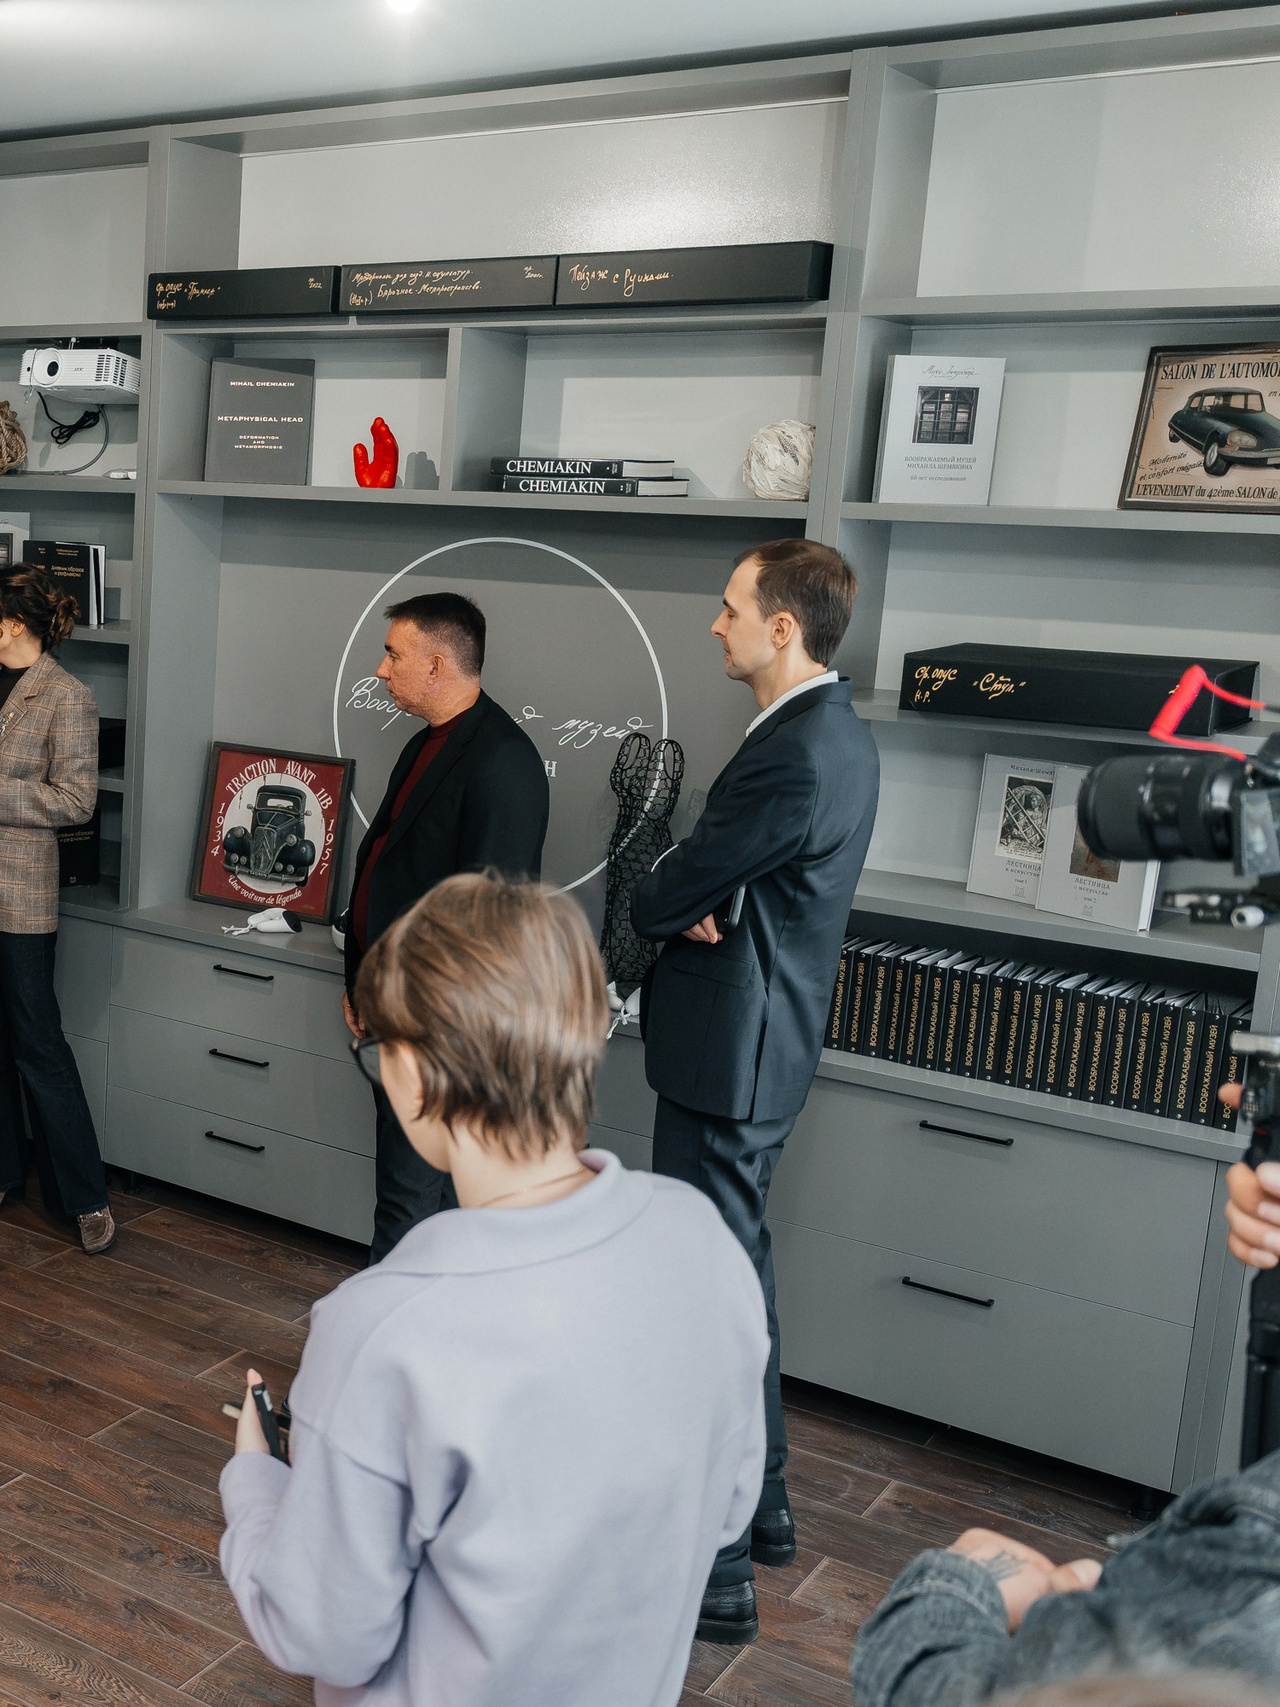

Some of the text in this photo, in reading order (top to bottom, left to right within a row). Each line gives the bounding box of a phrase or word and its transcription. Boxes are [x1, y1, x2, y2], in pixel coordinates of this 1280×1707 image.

[1160, 361, 1280, 380] SALON DE L'AUTOMO
[506, 460, 592, 474] CHEMIAKIN
[519, 480, 606, 493] CHEMIAKIN
[1135, 484, 1196, 497] L'EVENEMENT
[1195, 485, 1206, 497] du
[1236, 487, 1267, 499] SALON
[1267, 487, 1277, 500] de
[931, 667, 957, 691] опус
[552, 716, 654, 749] музей
[226, 758, 333, 810] TRACTION AVANT 11B
[228, 874, 240, 892] Une
[241, 888, 266, 904] voiture
[266, 896, 276, 905] de
[276, 888, 302, 906] légende
[1006, 860, 1042, 872] ЛЕСТНИЦА
[1074, 877, 1110, 890] ЛЕСТНИЦА
[832, 984, 844, 1039] ВООБРАЖАЕМЫЙ
[850, 987, 863, 1043] ВООБРАЖАЕМЫЙ
[870, 990, 882, 1047] ВООБРАЖАЕМЫЙ
[889, 994, 900, 1049] ВООБРАЖАЕМЫЙ
[907, 998, 919, 1055] ВООБРАЖАЕМЫЙ
[927, 1002, 939, 1059] ВООБРАЖАЕМЫЙ
[945, 980, 961, 1062] ВООБРАЖАЕМЫЙ МУЗЕЙ
[965, 1008, 978, 1066] ВООБРАЖАЕМЫЙ
[986, 987, 1002, 1070] ВООБРАЖАЕМЫЙ МУЗЕЙ
[1005, 991, 1021, 1074] ВООБРАЖАЕМЫЙ МУЗЕЙ
[1025, 995, 1042, 1078] ВООБРАЖАЕМЫЙ МУЗЕЙ
[1047, 998, 1063, 1083] ВООБРАЖАЕМЫЙ МУЗЕЙ
[1068, 1002, 1085, 1088] ВООБРАЖАЕМЫЙ МУЗЕЙ
[1089, 1005, 1106, 1091] ВООБРАЖАЕМЫЙ МУЗЕЙ
[1110, 1009, 1127, 1095] ВООБРАЖАЕМЫЙ МУЗЕЙ
[1132, 1012, 1150, 1099] ВООБРАЖАЕМЫЙ МУЗЕЙ
[1154, 1016, 1172, 1103] ВООБРАЖАЕМЫЙ МУЗЕЙ
[1177, 1021, 1196, 1109] ВООБРАЖАЕМЫЙ МУЗЕЙ
[1199, 1025, 1218, 1113] ВООБРАЖАЕМЫЙ МУЗЕЙ
[1223, 1056, 1237, 1118] ВООАЕМЫЙ
